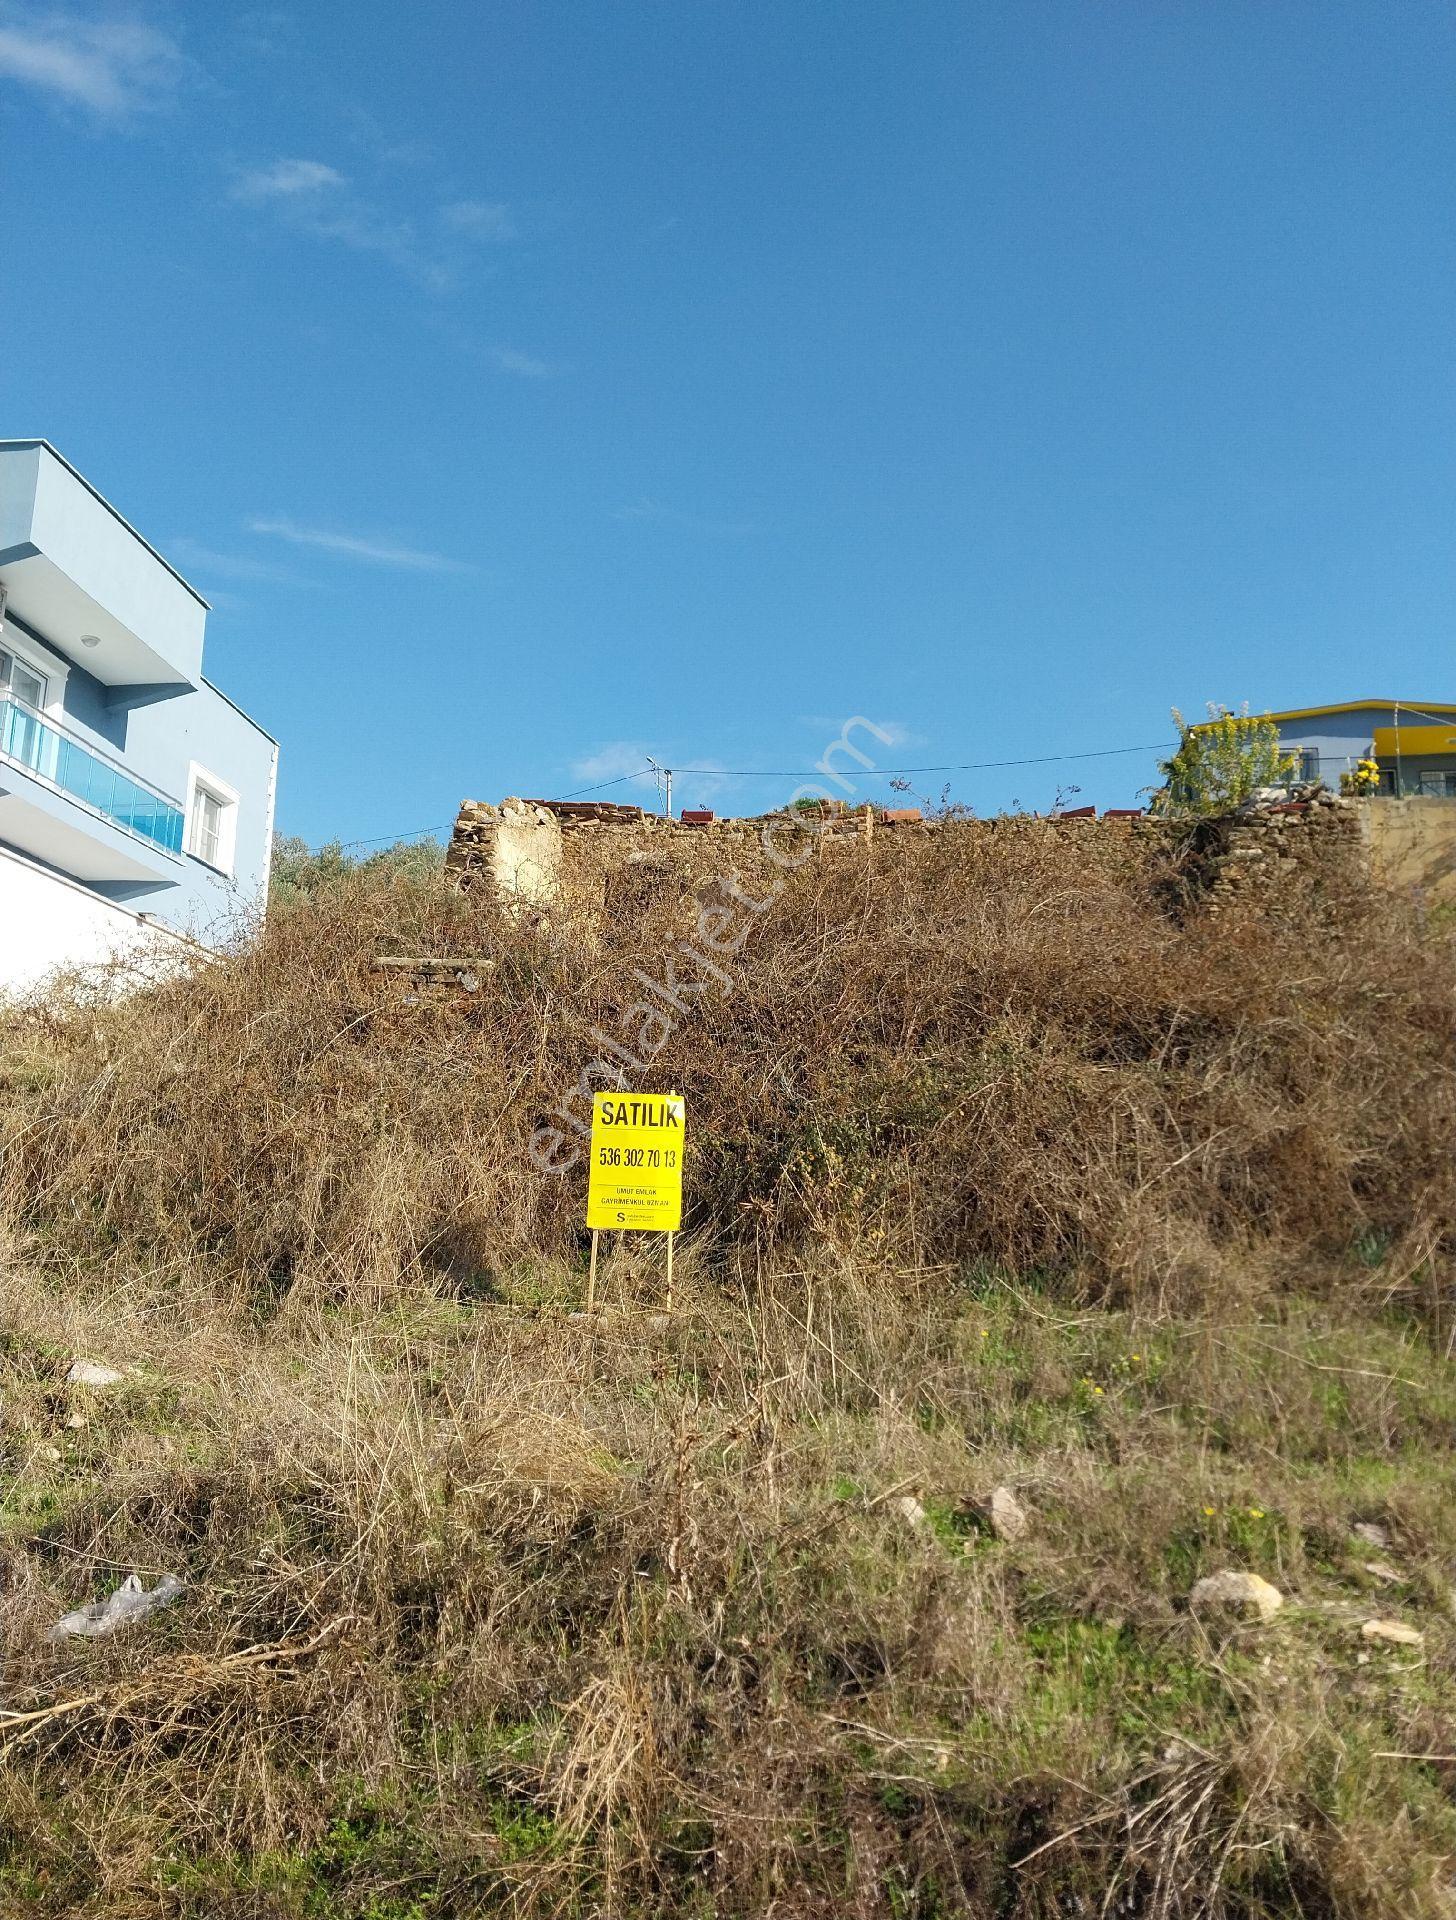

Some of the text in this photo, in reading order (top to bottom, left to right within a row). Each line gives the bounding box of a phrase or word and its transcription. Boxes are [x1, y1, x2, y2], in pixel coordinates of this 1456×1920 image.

[601, 1102, 678, 1127] SATILIK
[600, 1148, 675, 1168] 536 302 70 13
[616, 1187, 657, 1196] UMUT EMLAK
